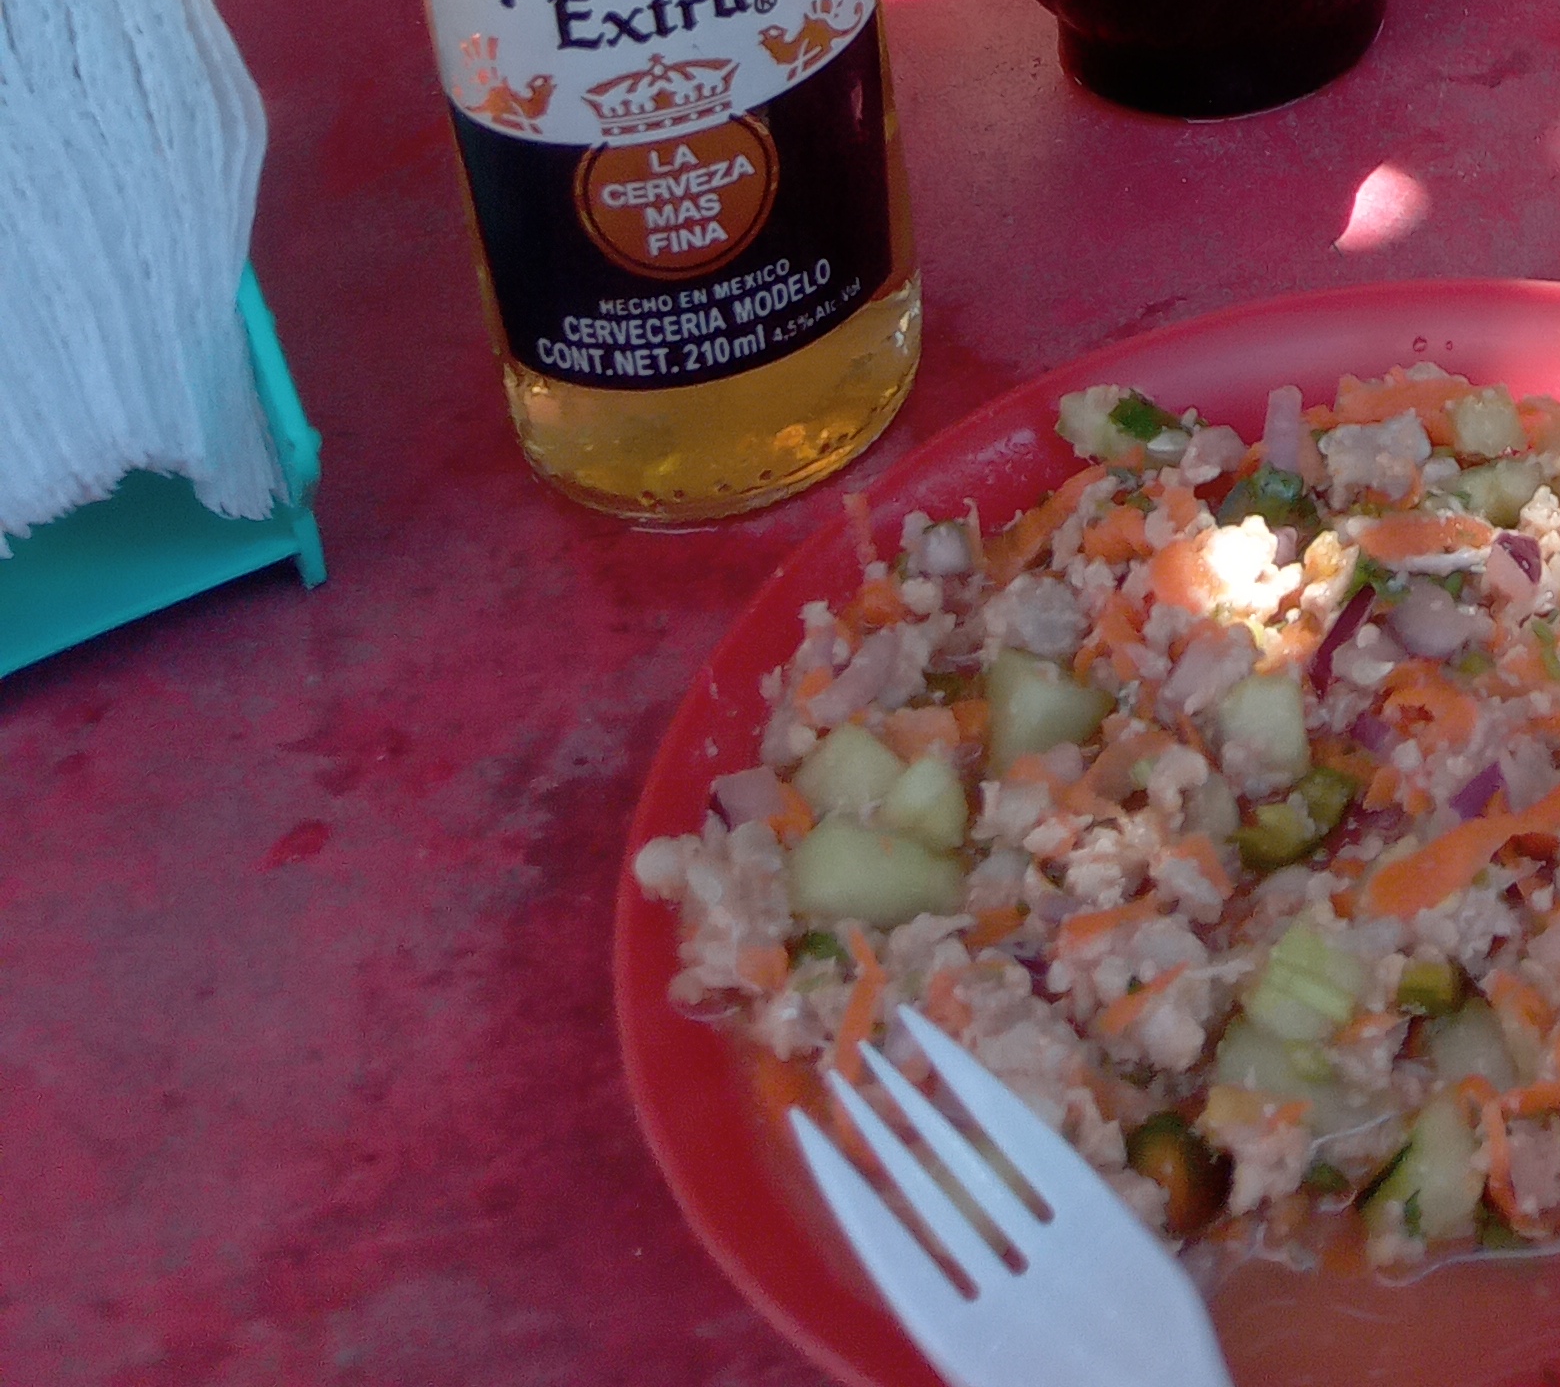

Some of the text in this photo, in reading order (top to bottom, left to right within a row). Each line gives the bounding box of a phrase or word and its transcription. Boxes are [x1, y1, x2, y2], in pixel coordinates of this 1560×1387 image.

[602, 154, 756, 207] CERVEZA
[650, 144, 700, 174] LA
[645, 193, 721, 228] MAS
[648, 221, 728, 256] FINA
[563, 258, 831, 346] CERVECERIA MODELO
[600, 258, 790, 317] HECHO EN MEXICO
